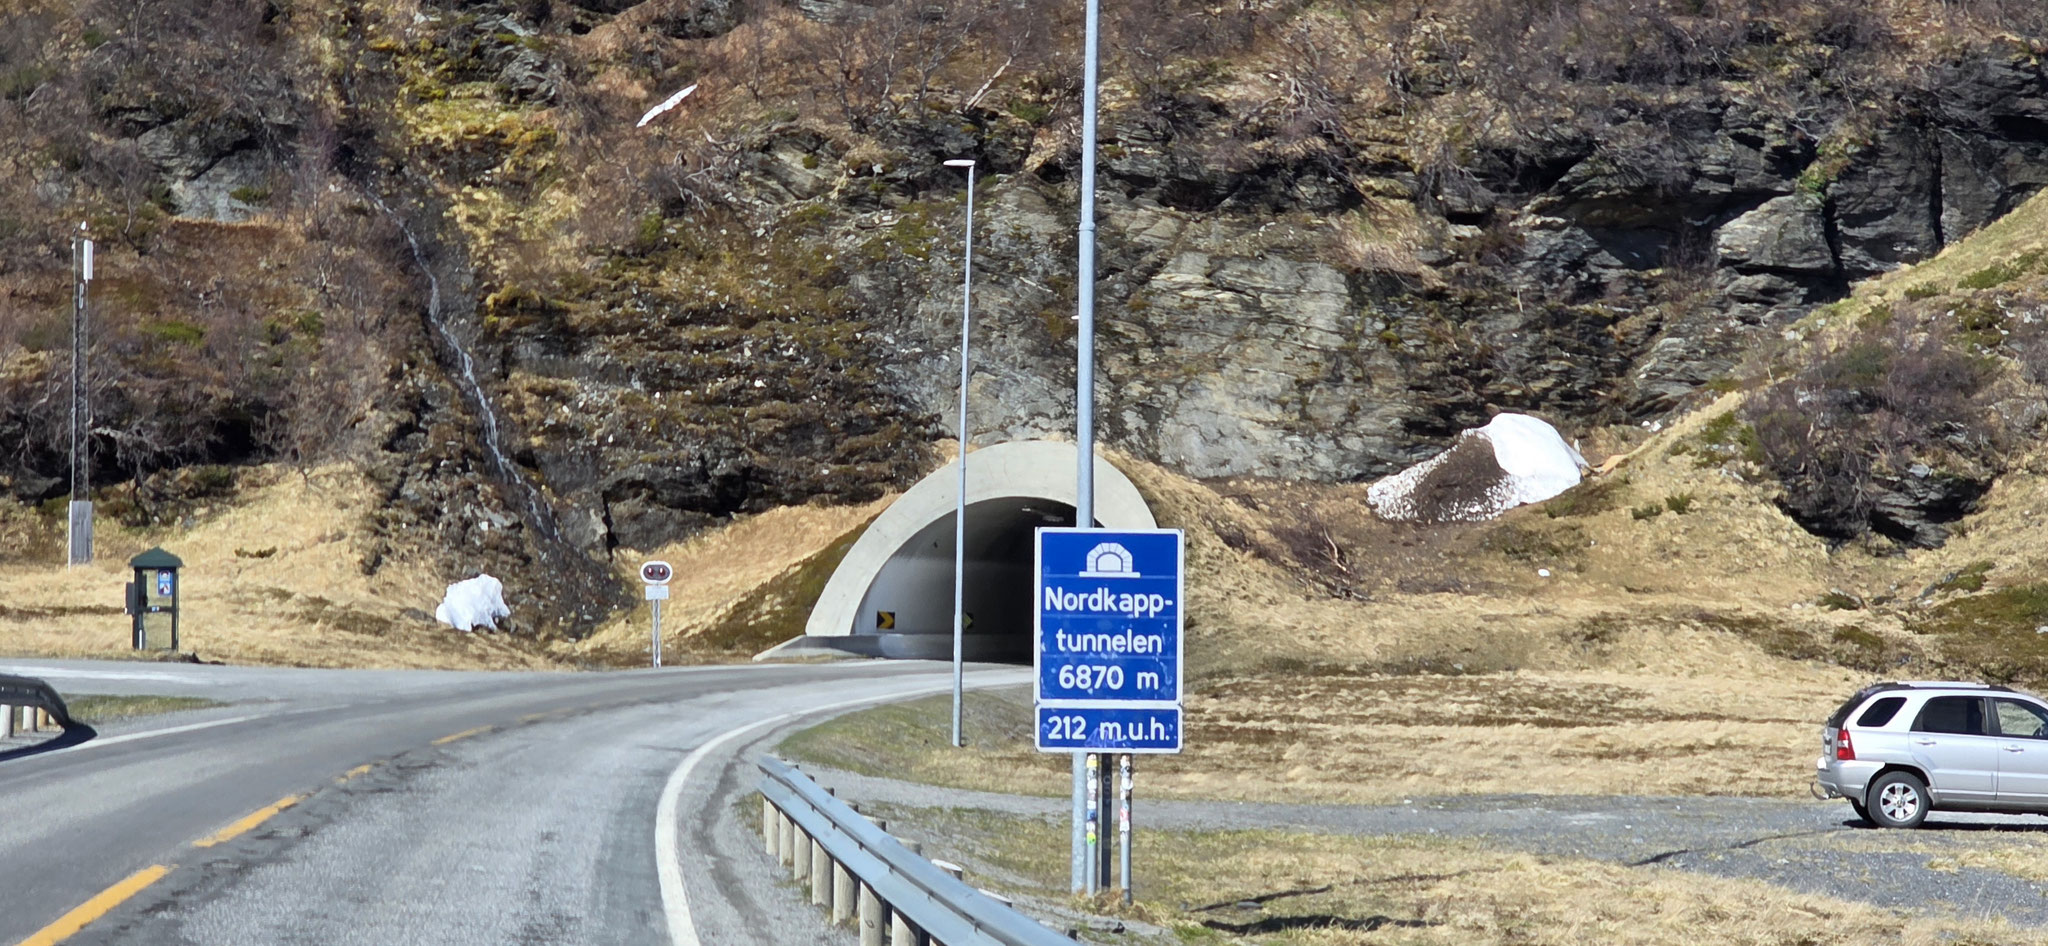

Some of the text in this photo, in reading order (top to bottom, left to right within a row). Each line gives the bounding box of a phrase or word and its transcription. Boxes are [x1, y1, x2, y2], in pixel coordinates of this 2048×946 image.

[1044, 586, 1173, 618] Nordkapp-
[1056, 628, 1162, 653] tunnelen
[1058, 664, 1159, 690] 6870 m
[1047, 715, 1087, 740] 212
[1099, 717, 1170, 741] m.u.h.
